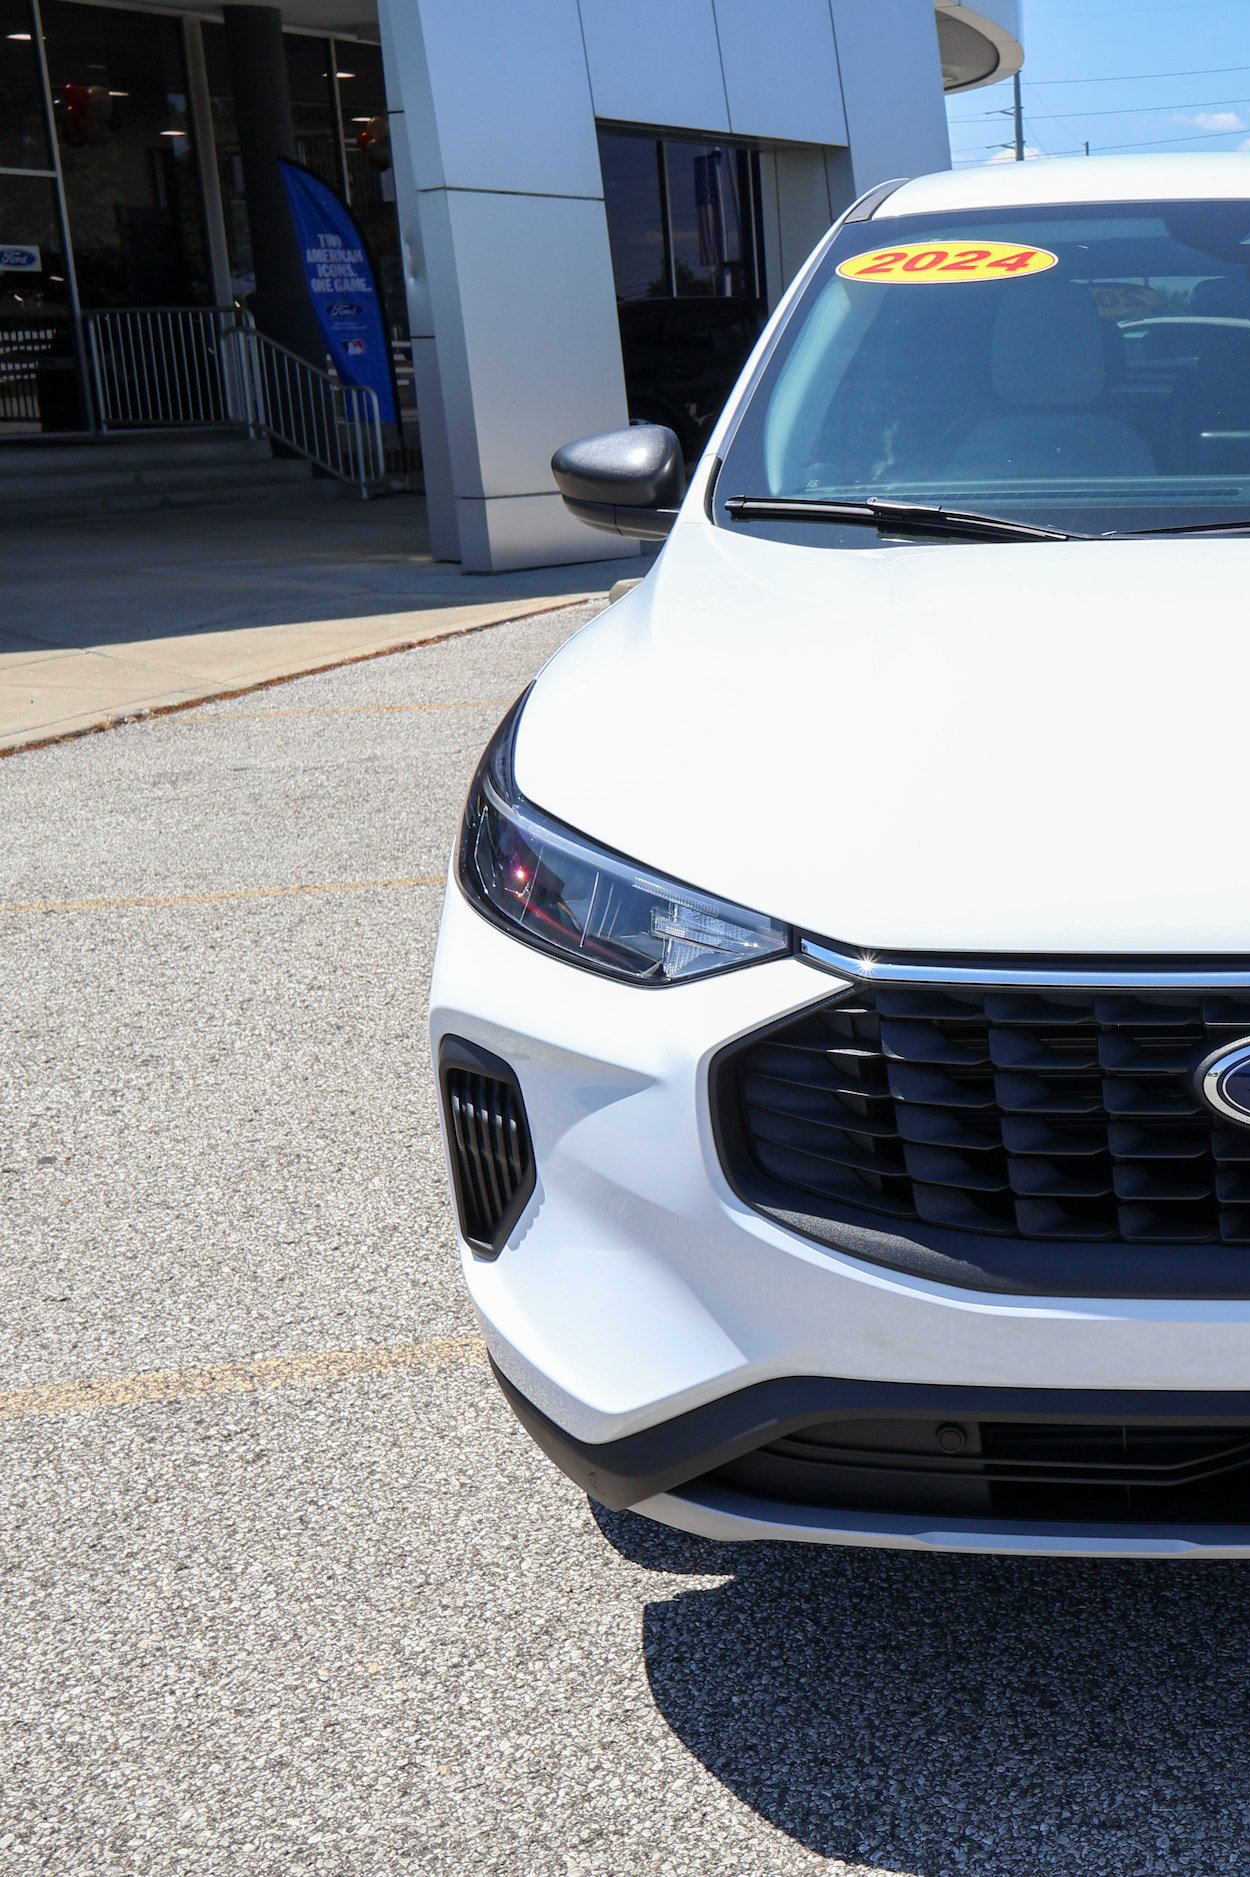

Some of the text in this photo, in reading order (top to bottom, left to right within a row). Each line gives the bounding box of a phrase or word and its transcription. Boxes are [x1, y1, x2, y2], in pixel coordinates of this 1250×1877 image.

[2, 249, 28, 264] Ford
[306, 248, 364, 263] AMERICAN
[854, 250, 1038, 275] 2024
[316, 263, 358, 278] ICONS.
[310, 278, 373, 293] ONE GAME.
[330, 304, 357, 316] Ford
